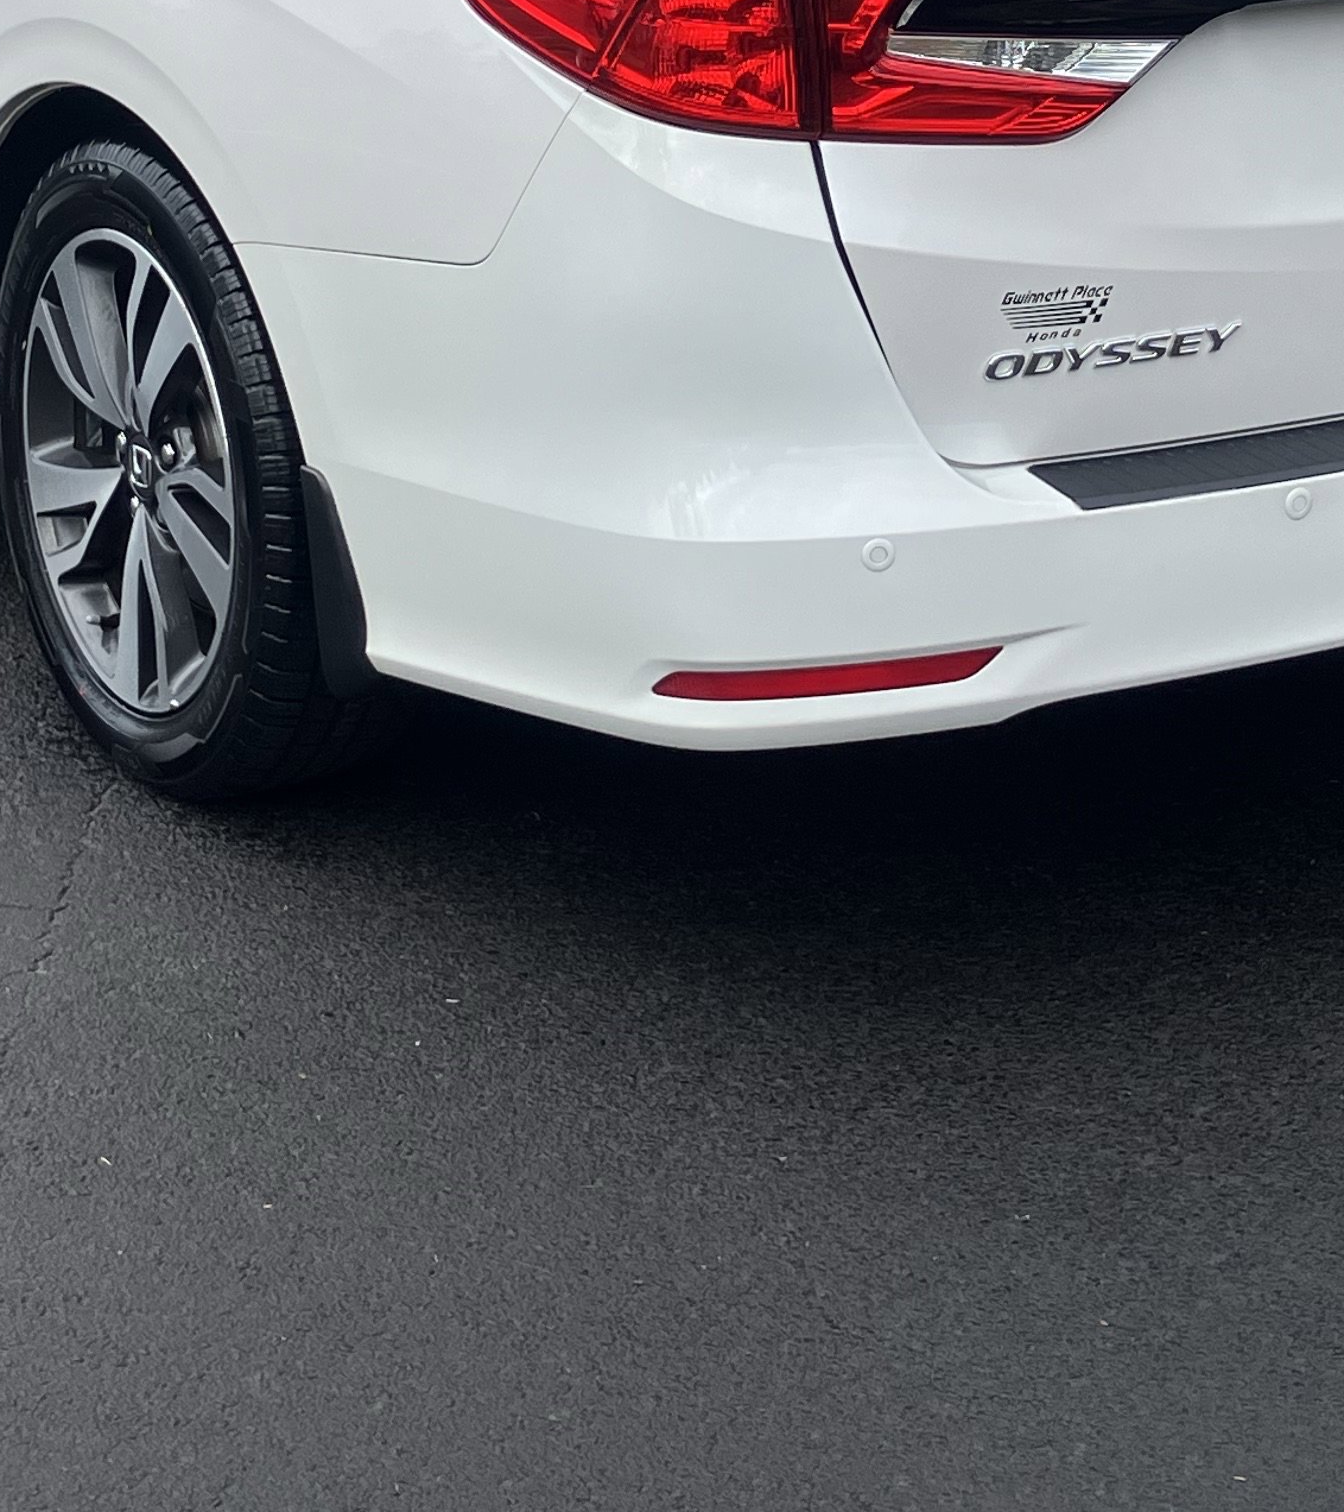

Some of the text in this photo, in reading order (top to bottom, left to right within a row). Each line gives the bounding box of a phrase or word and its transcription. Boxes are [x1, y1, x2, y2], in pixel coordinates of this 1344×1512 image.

[1001, 284, 1114, 306] Gwinnett Place
[1025, 327, 1083, 344] Honda
[983, 319, 1243, 383] ODYSSEY
